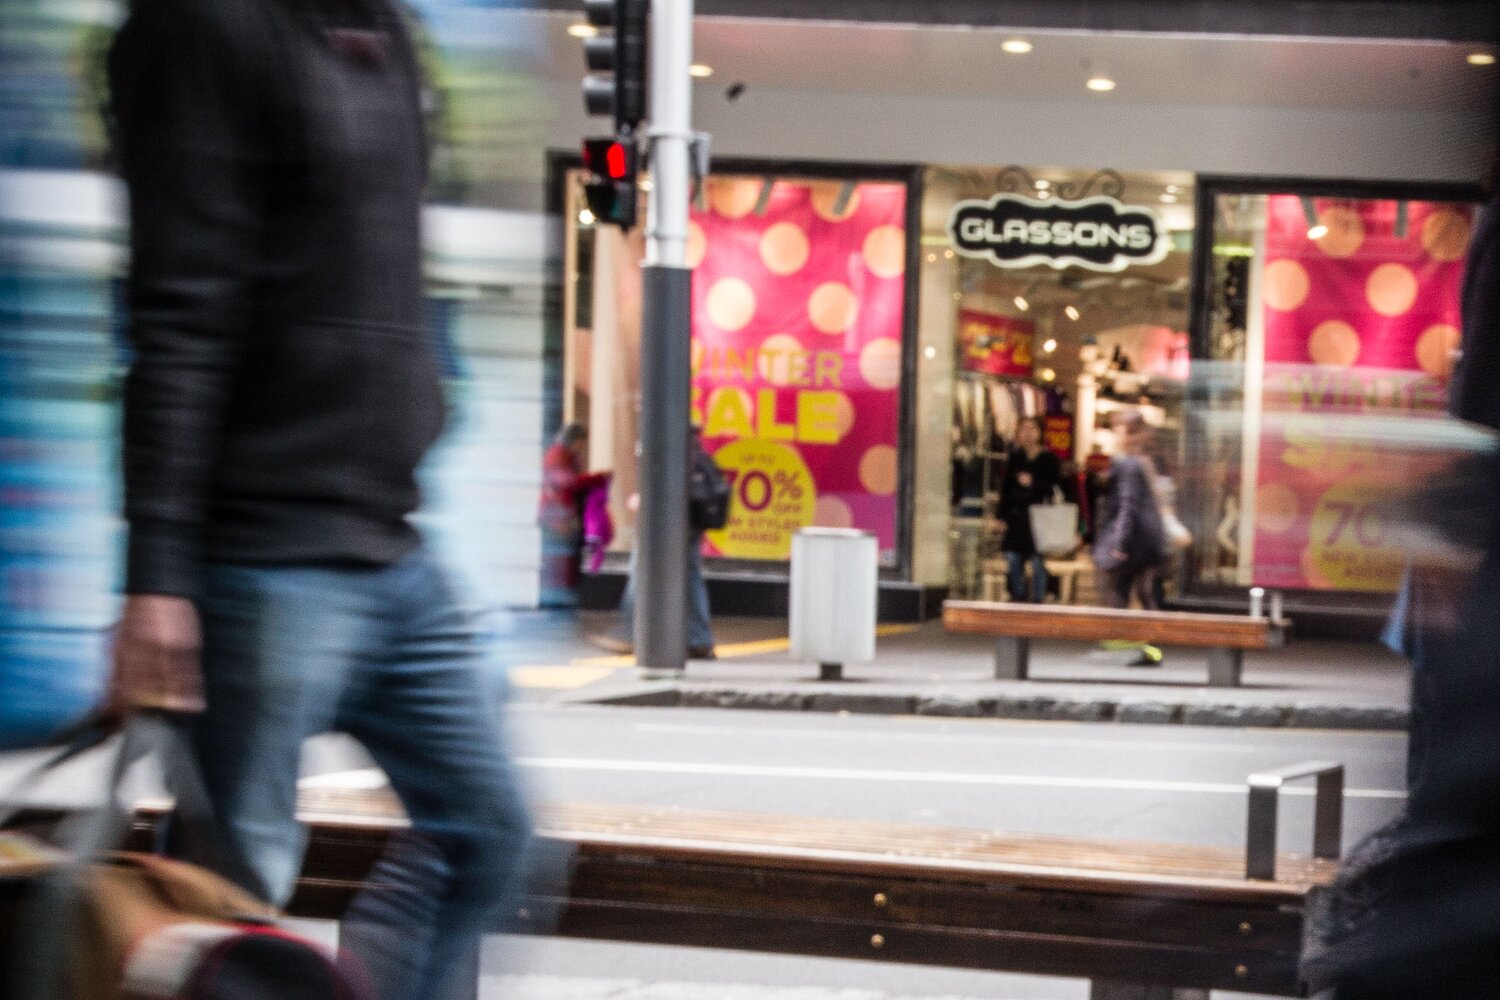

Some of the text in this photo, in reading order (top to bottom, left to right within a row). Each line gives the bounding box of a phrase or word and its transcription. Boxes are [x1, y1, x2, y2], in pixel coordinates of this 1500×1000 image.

[960, 217, 1152, 249] GLASSONS
[691, 349, 844, 387] INTER
[1284, 372, 1447, 411] WINTE
[691, 387, 840, 445] ALE
